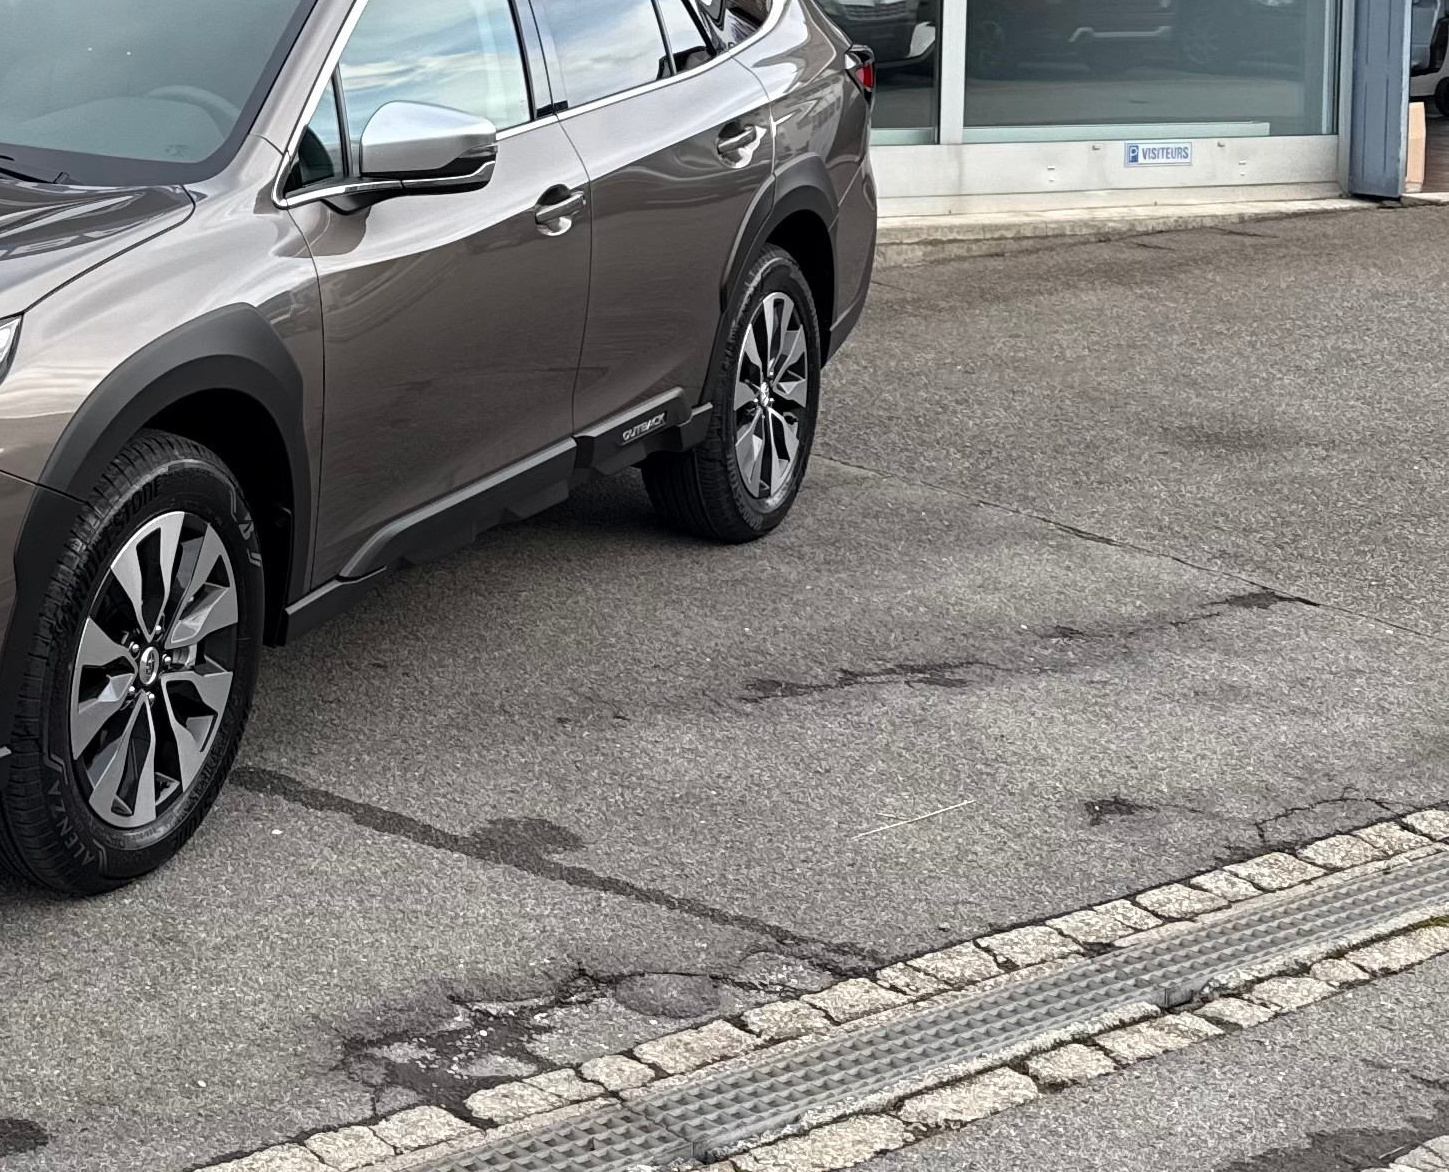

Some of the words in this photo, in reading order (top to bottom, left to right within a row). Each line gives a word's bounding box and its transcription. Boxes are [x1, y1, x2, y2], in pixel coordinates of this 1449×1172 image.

[1141, 146, 1189, 161] VISITEURS
[622, 412, 666, 441] OUTBACK
[48, 779, 96, 866] ALENZA
